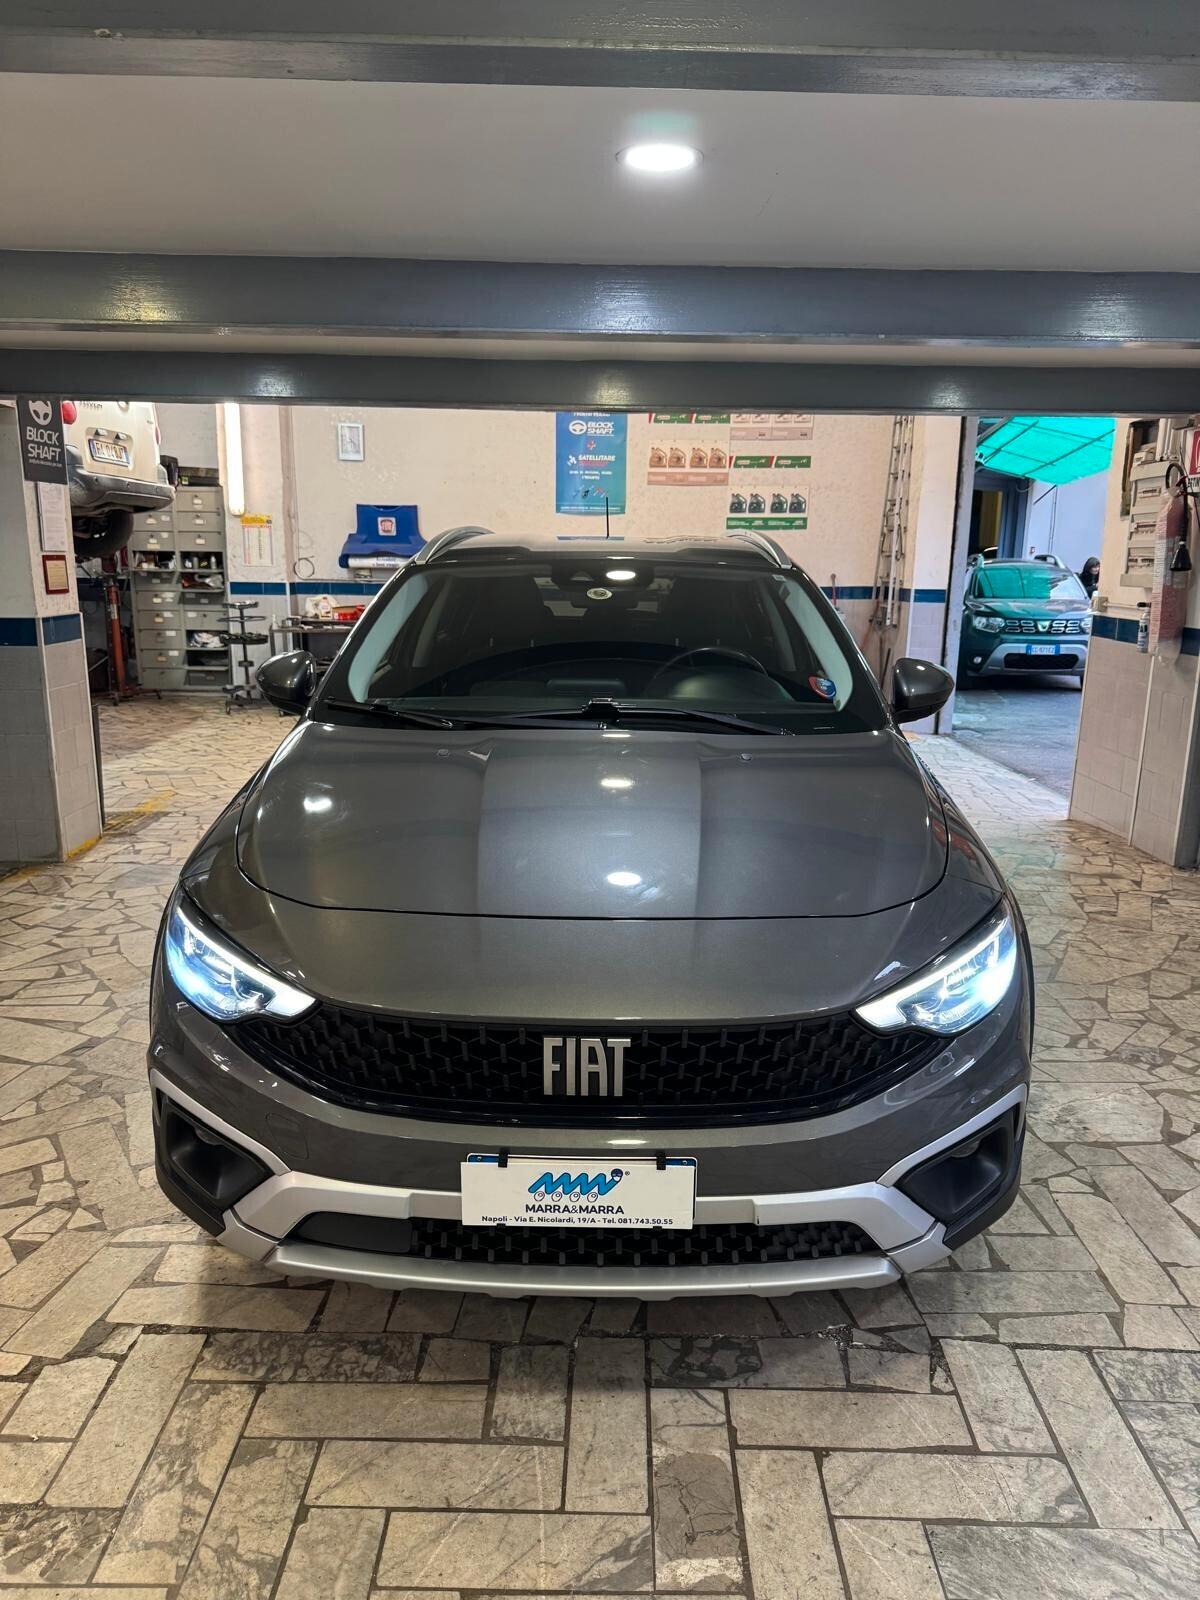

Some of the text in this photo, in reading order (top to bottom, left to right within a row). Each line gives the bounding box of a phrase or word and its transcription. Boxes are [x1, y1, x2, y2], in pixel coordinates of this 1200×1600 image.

[26, 427, 60, 446] BLOCK
[27, 443, 62, 461] SHAFT
[543, 1037, 631, 1096] FIAT
[525, 1204, 624, 1214] MARRA&MARRA
[481, 1215, 508, 1223] Napoli
[537, 1216, 576, 1224] Nicolardi,
[618, 1217, 673, 1225] 081.743.50.55
